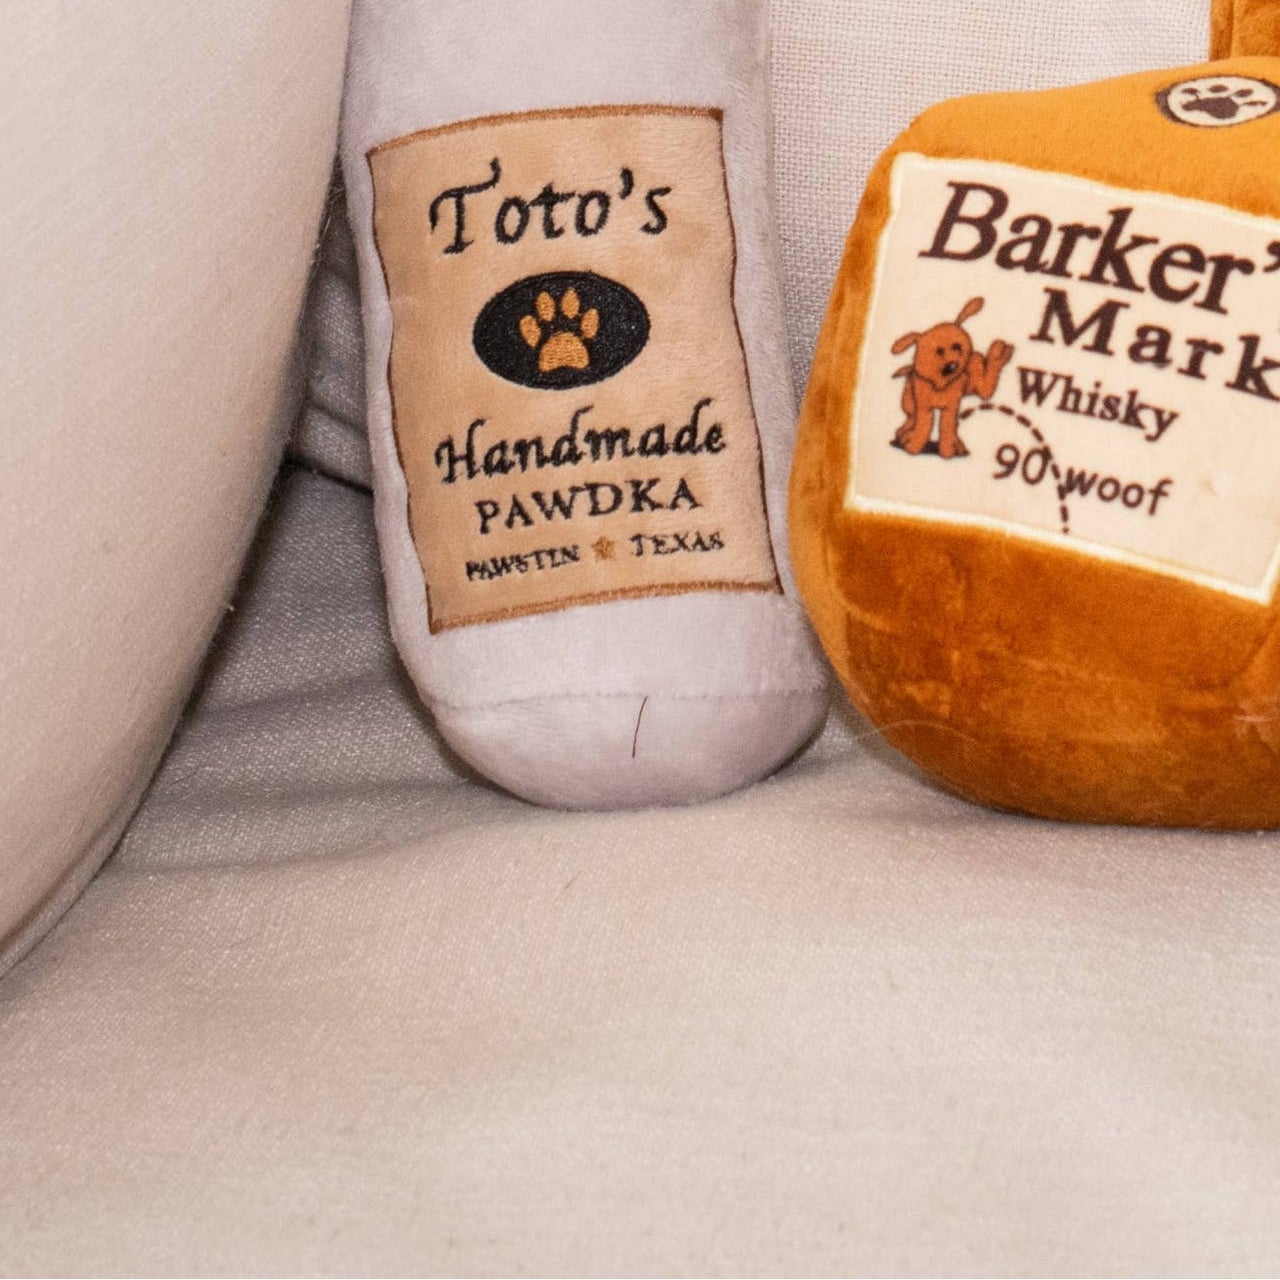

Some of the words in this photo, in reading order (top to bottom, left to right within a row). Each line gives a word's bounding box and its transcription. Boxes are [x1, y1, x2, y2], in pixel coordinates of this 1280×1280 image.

[429, 157, 673, 255] Toto's
[434, 397, 727, 485] Handmade
[1018, 365, 1179, 442] Whisky
[475, 477, 705, 535] PAWDKA
[993, 443, 1050, 487] 90
[1064, 461, 1173, 516] woof
[465, 546, 581, 582] PAWSTIN
[629, 531, 726, 560] TEXAS
